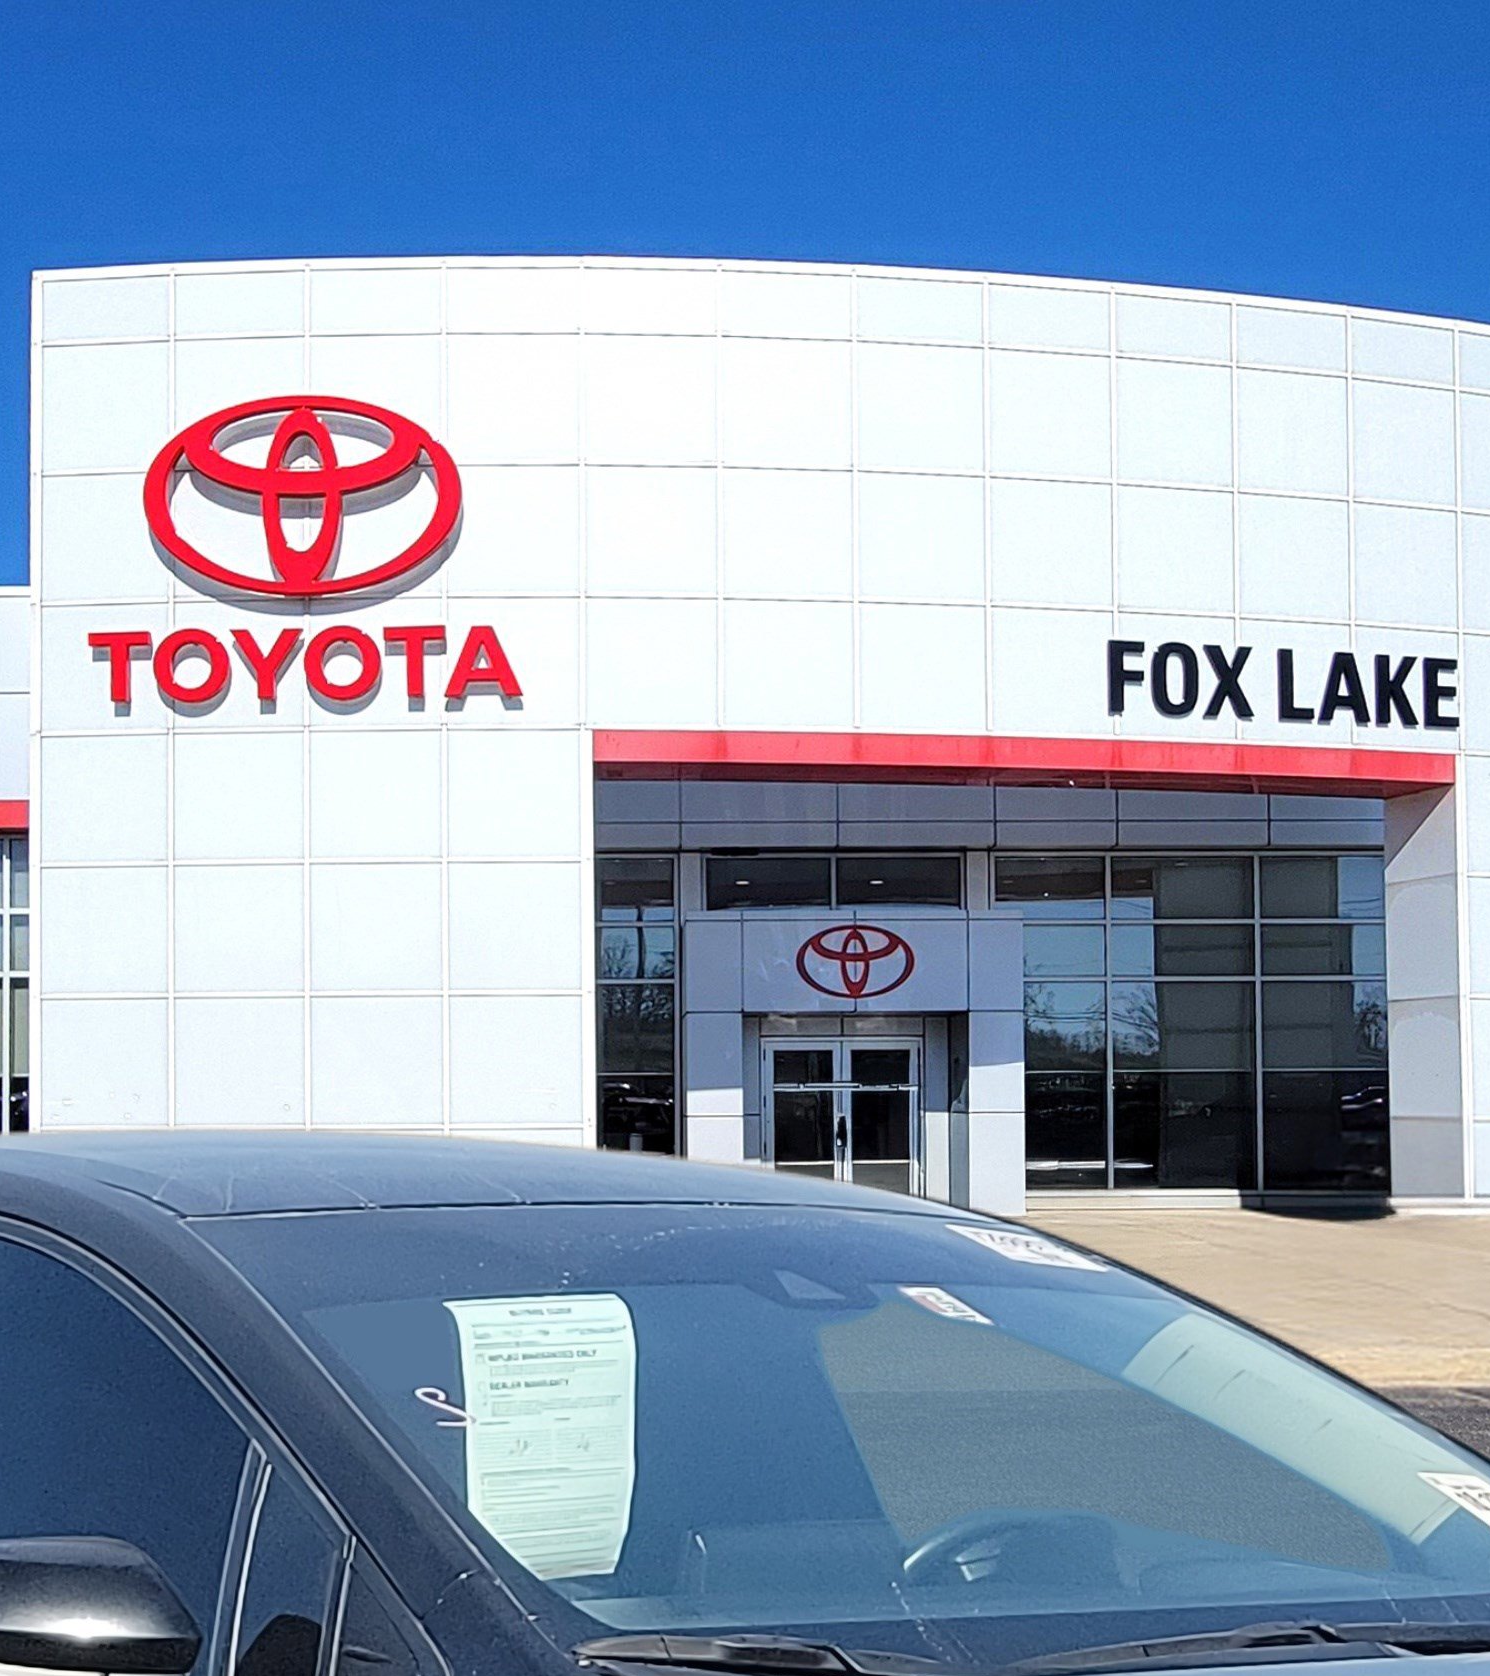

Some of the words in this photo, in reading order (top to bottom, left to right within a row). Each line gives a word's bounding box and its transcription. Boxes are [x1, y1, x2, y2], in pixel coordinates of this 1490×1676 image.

[88, 625, 523, 705] TOYOTA
[1107, 639, 1255, 721] FOX
[1277, 647, 1460, 729] LAKE
